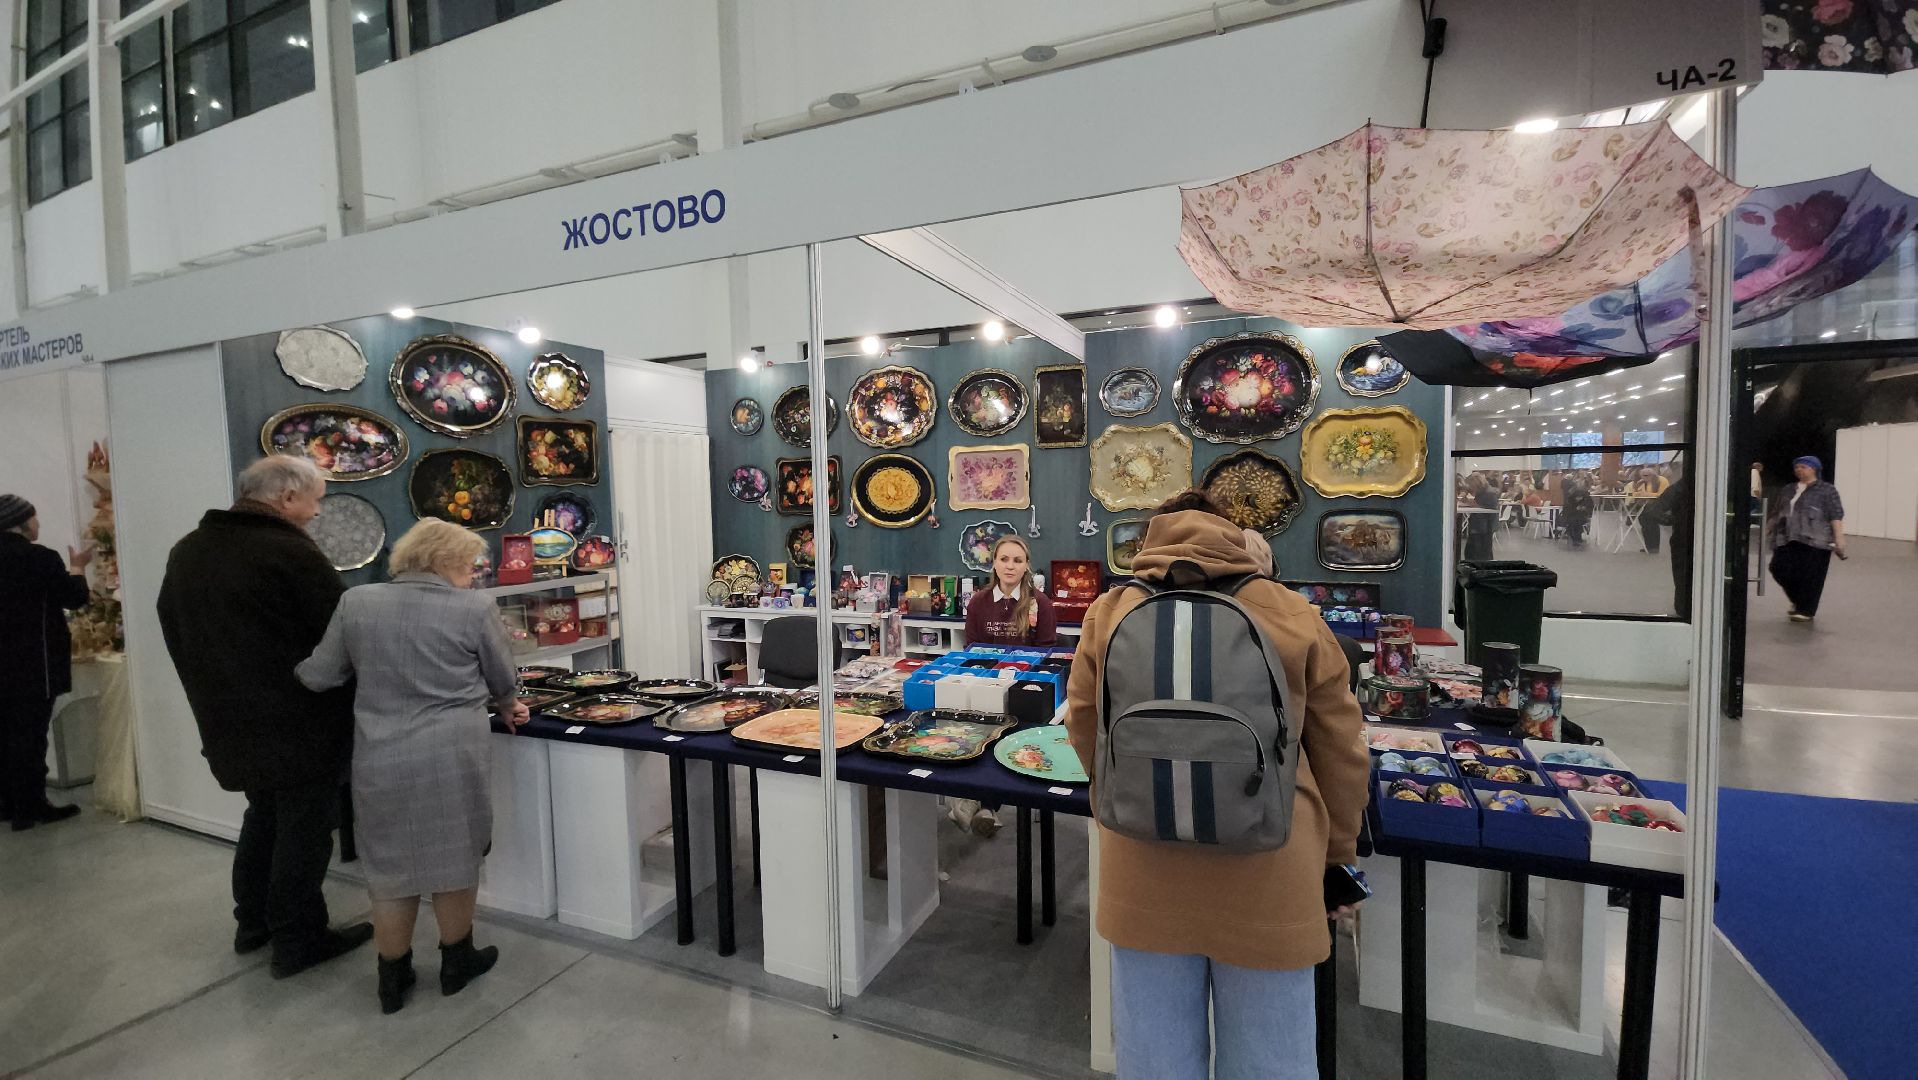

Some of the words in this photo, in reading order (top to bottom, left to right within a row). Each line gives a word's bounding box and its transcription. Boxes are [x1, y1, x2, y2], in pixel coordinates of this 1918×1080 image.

[1656, 58, 1737, 91] ЧА-2
[562, 189, 726, 251] ЖОСТОВО
[22, 333, 83, 366] МАСТЕРОВ
